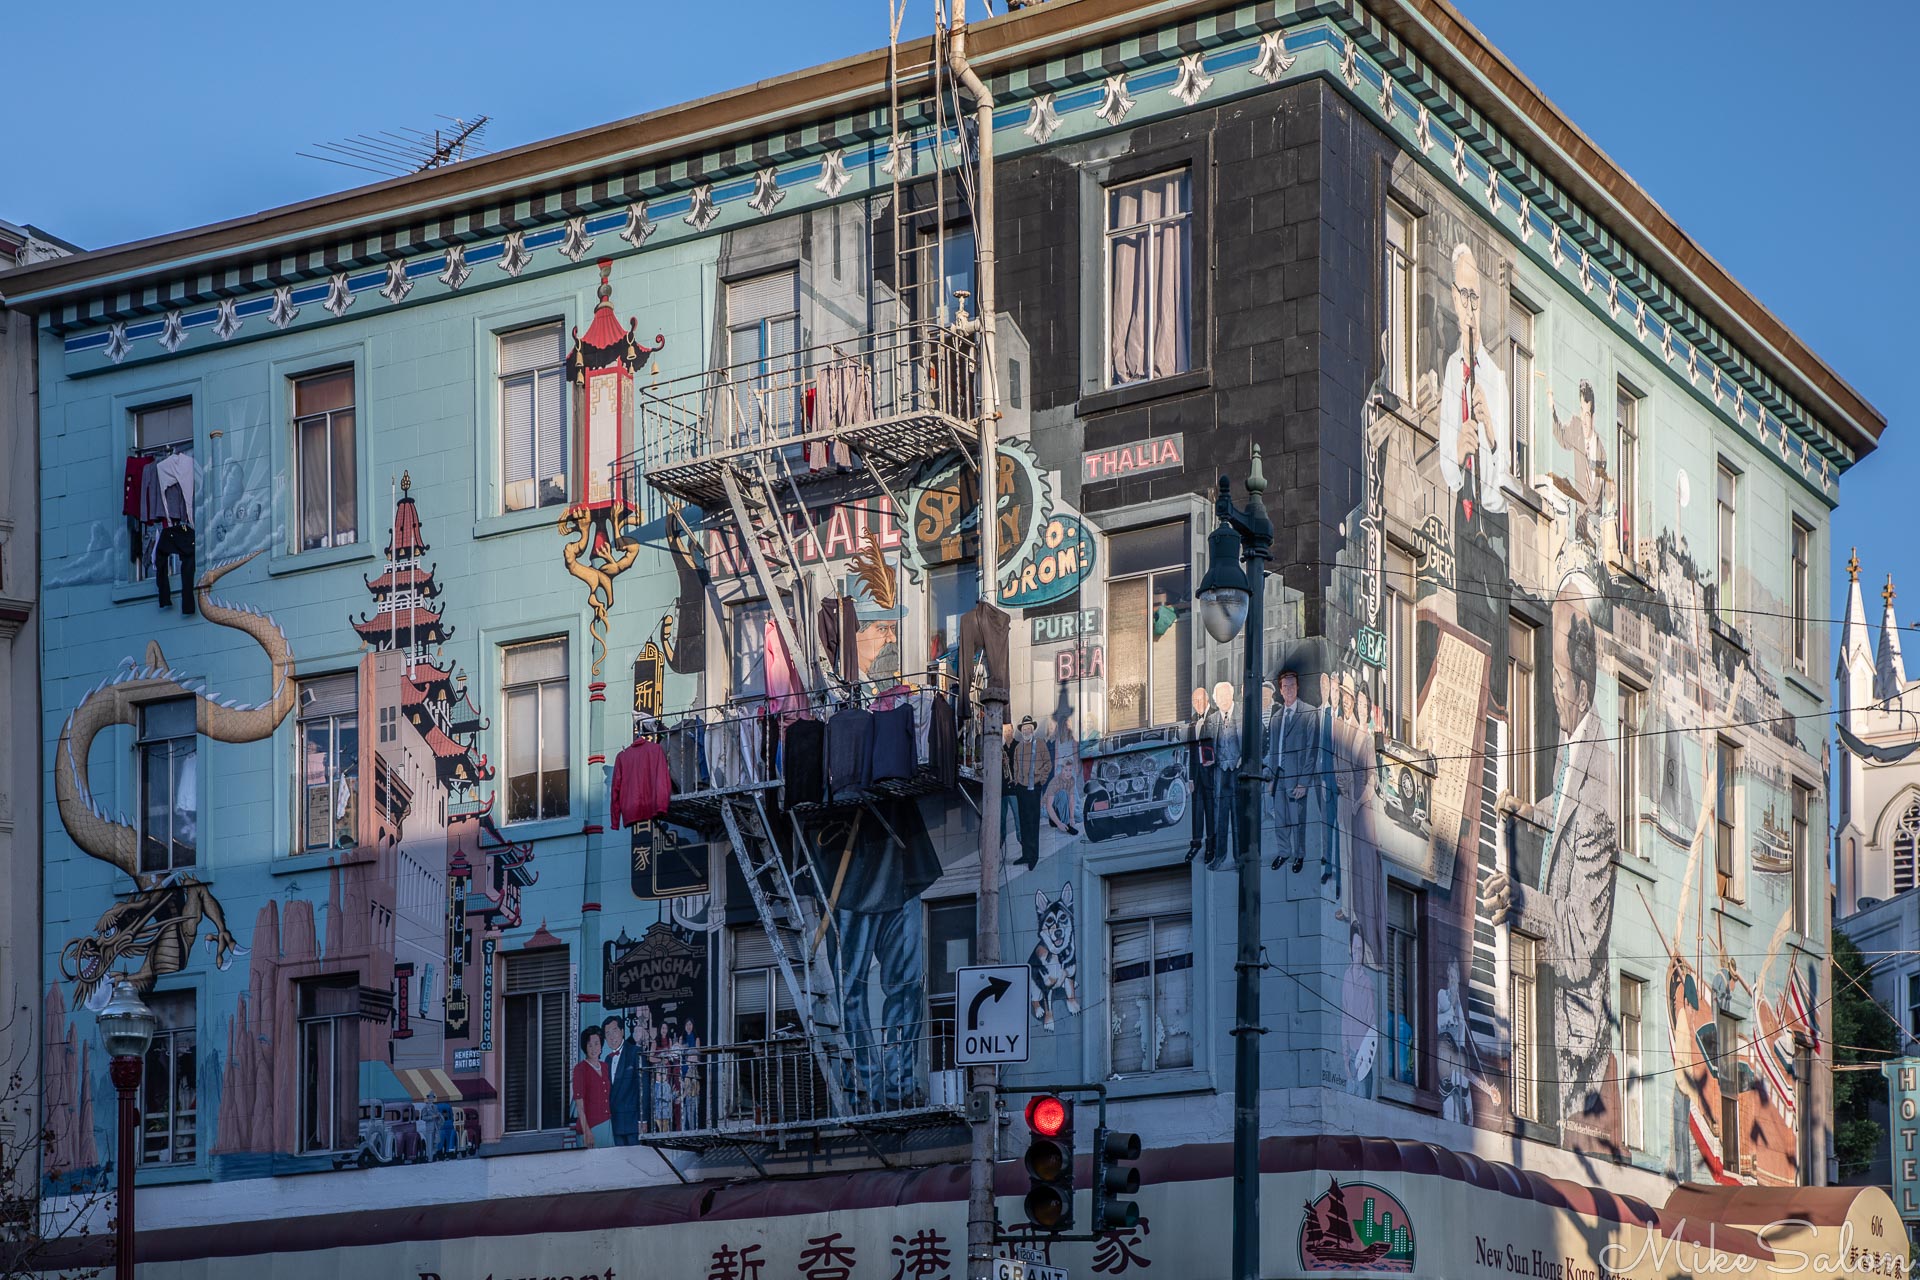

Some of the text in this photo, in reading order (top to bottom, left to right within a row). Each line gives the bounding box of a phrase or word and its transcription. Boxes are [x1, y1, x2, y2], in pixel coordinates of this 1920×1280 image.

[1085, 439, 1181, 479] THALIA
[1368, 408, 1377, 515] MULIN
[1367, 527, 1376, 612] ROUGE
[483, 941, 493, 1041] SING CHONG
[618, 957, 702, 989] SHANGHAI
[640, 974, 679, 992] LOW
[448, 1001, 465, 1011] HOTEL
[965, 1034, 1020, 1055] ONLY
[1898, 1067, 1919, 1212] HOTEL
[1871, 1215, 1884, 1238] 606
[1020, 1250, 1036, 1261] 1200
[1475, 1235, 1503, 1270] New
[1506, 1243, 1530, 1276] Sun
[1532, 1249, 1563, 1280] Hong
